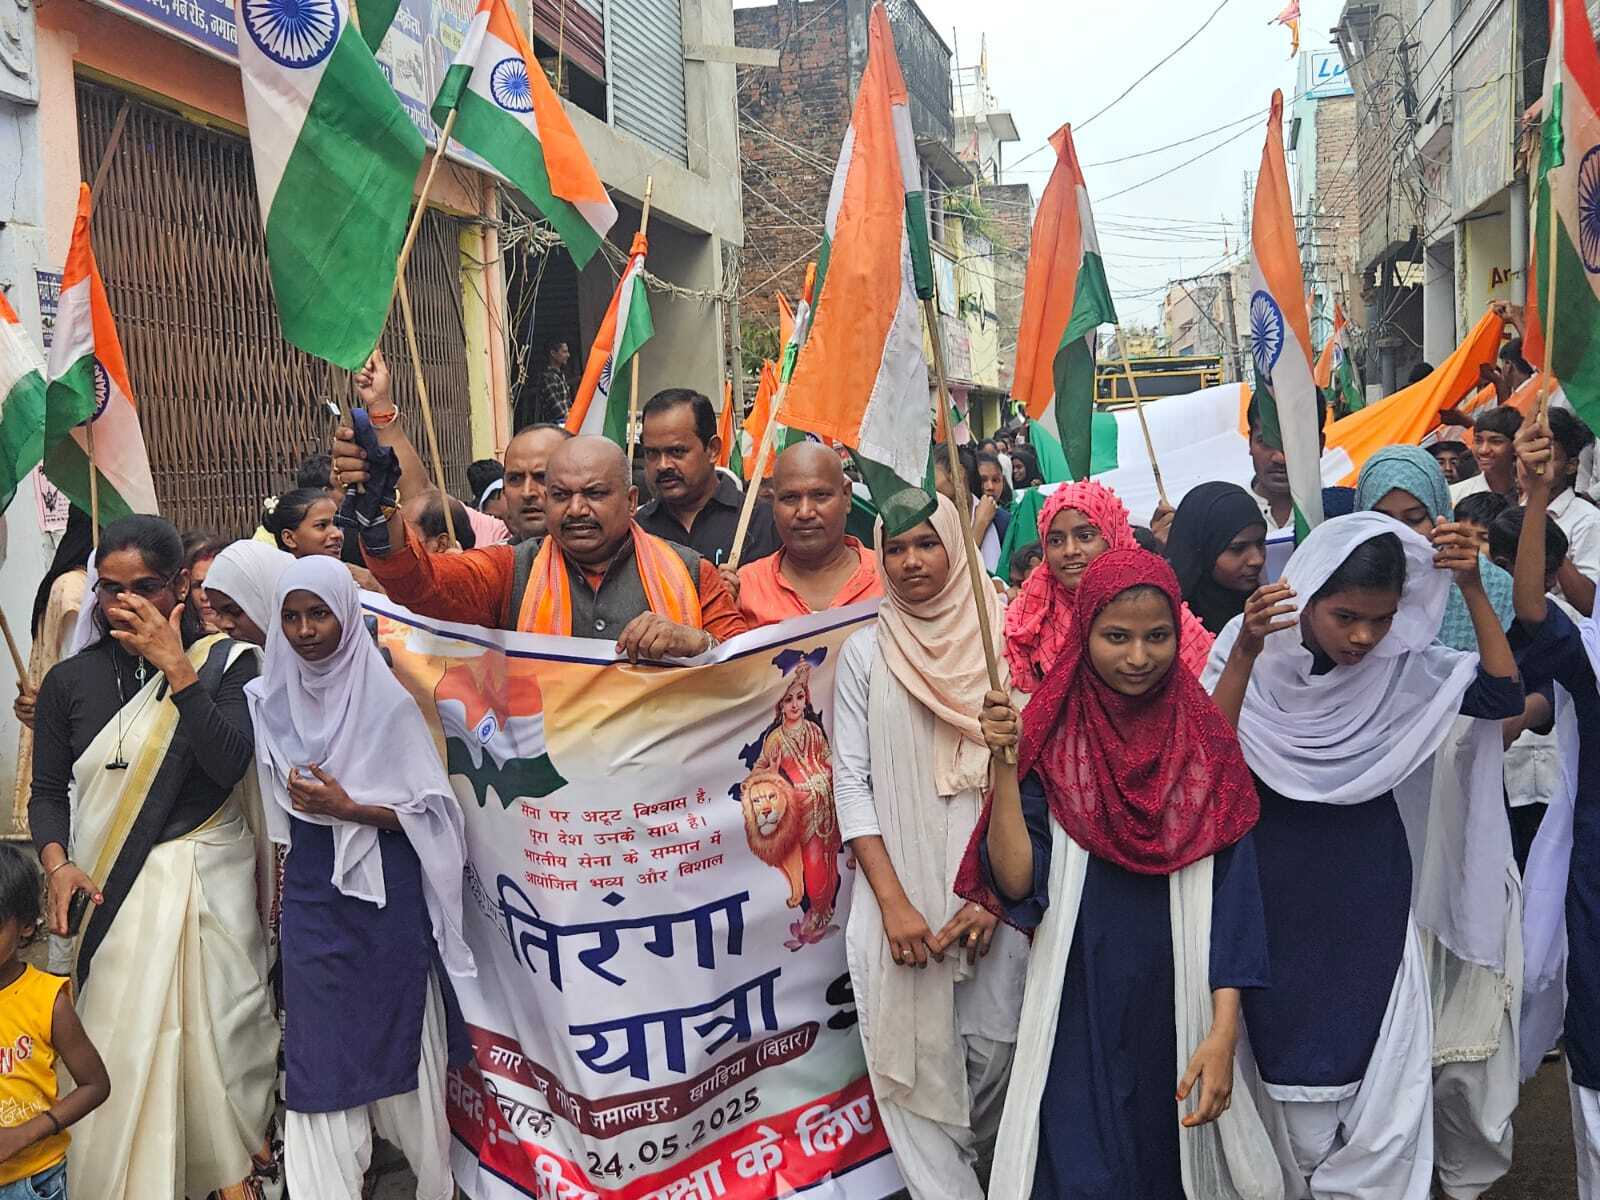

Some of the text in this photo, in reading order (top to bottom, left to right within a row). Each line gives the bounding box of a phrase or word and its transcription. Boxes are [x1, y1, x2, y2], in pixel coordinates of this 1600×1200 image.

[520, 800, 541, 820] सेना
[549, 809, 570, 823] पर
[582, 808, 622, 826] अटूट
[634, 796, 687, 819] विश्वास
[529, 827, 548, 846] पूरा
[558, 828, 583, 846] देश
[594, 826, 635, 845] उनके
[647, 821, 678, 838] साथ
[524, 830, 721, 868] भारतीय सेना के सम्मान में
[524, 852, 723, 891] आयोजित भव्य और विशाल
[497, 874, 750, 992] तिरंगा
[569, 966, 781, 1081] यात्रा
[489, 1045, 524, 1073] नगर
[755, 1027, 811, 1066] (बिहार)
[586, 1087, 762, 1180] 24.05.2025
[731, 1125, 784, 1179] के
[795, 1095, 873, 1157] लिए
